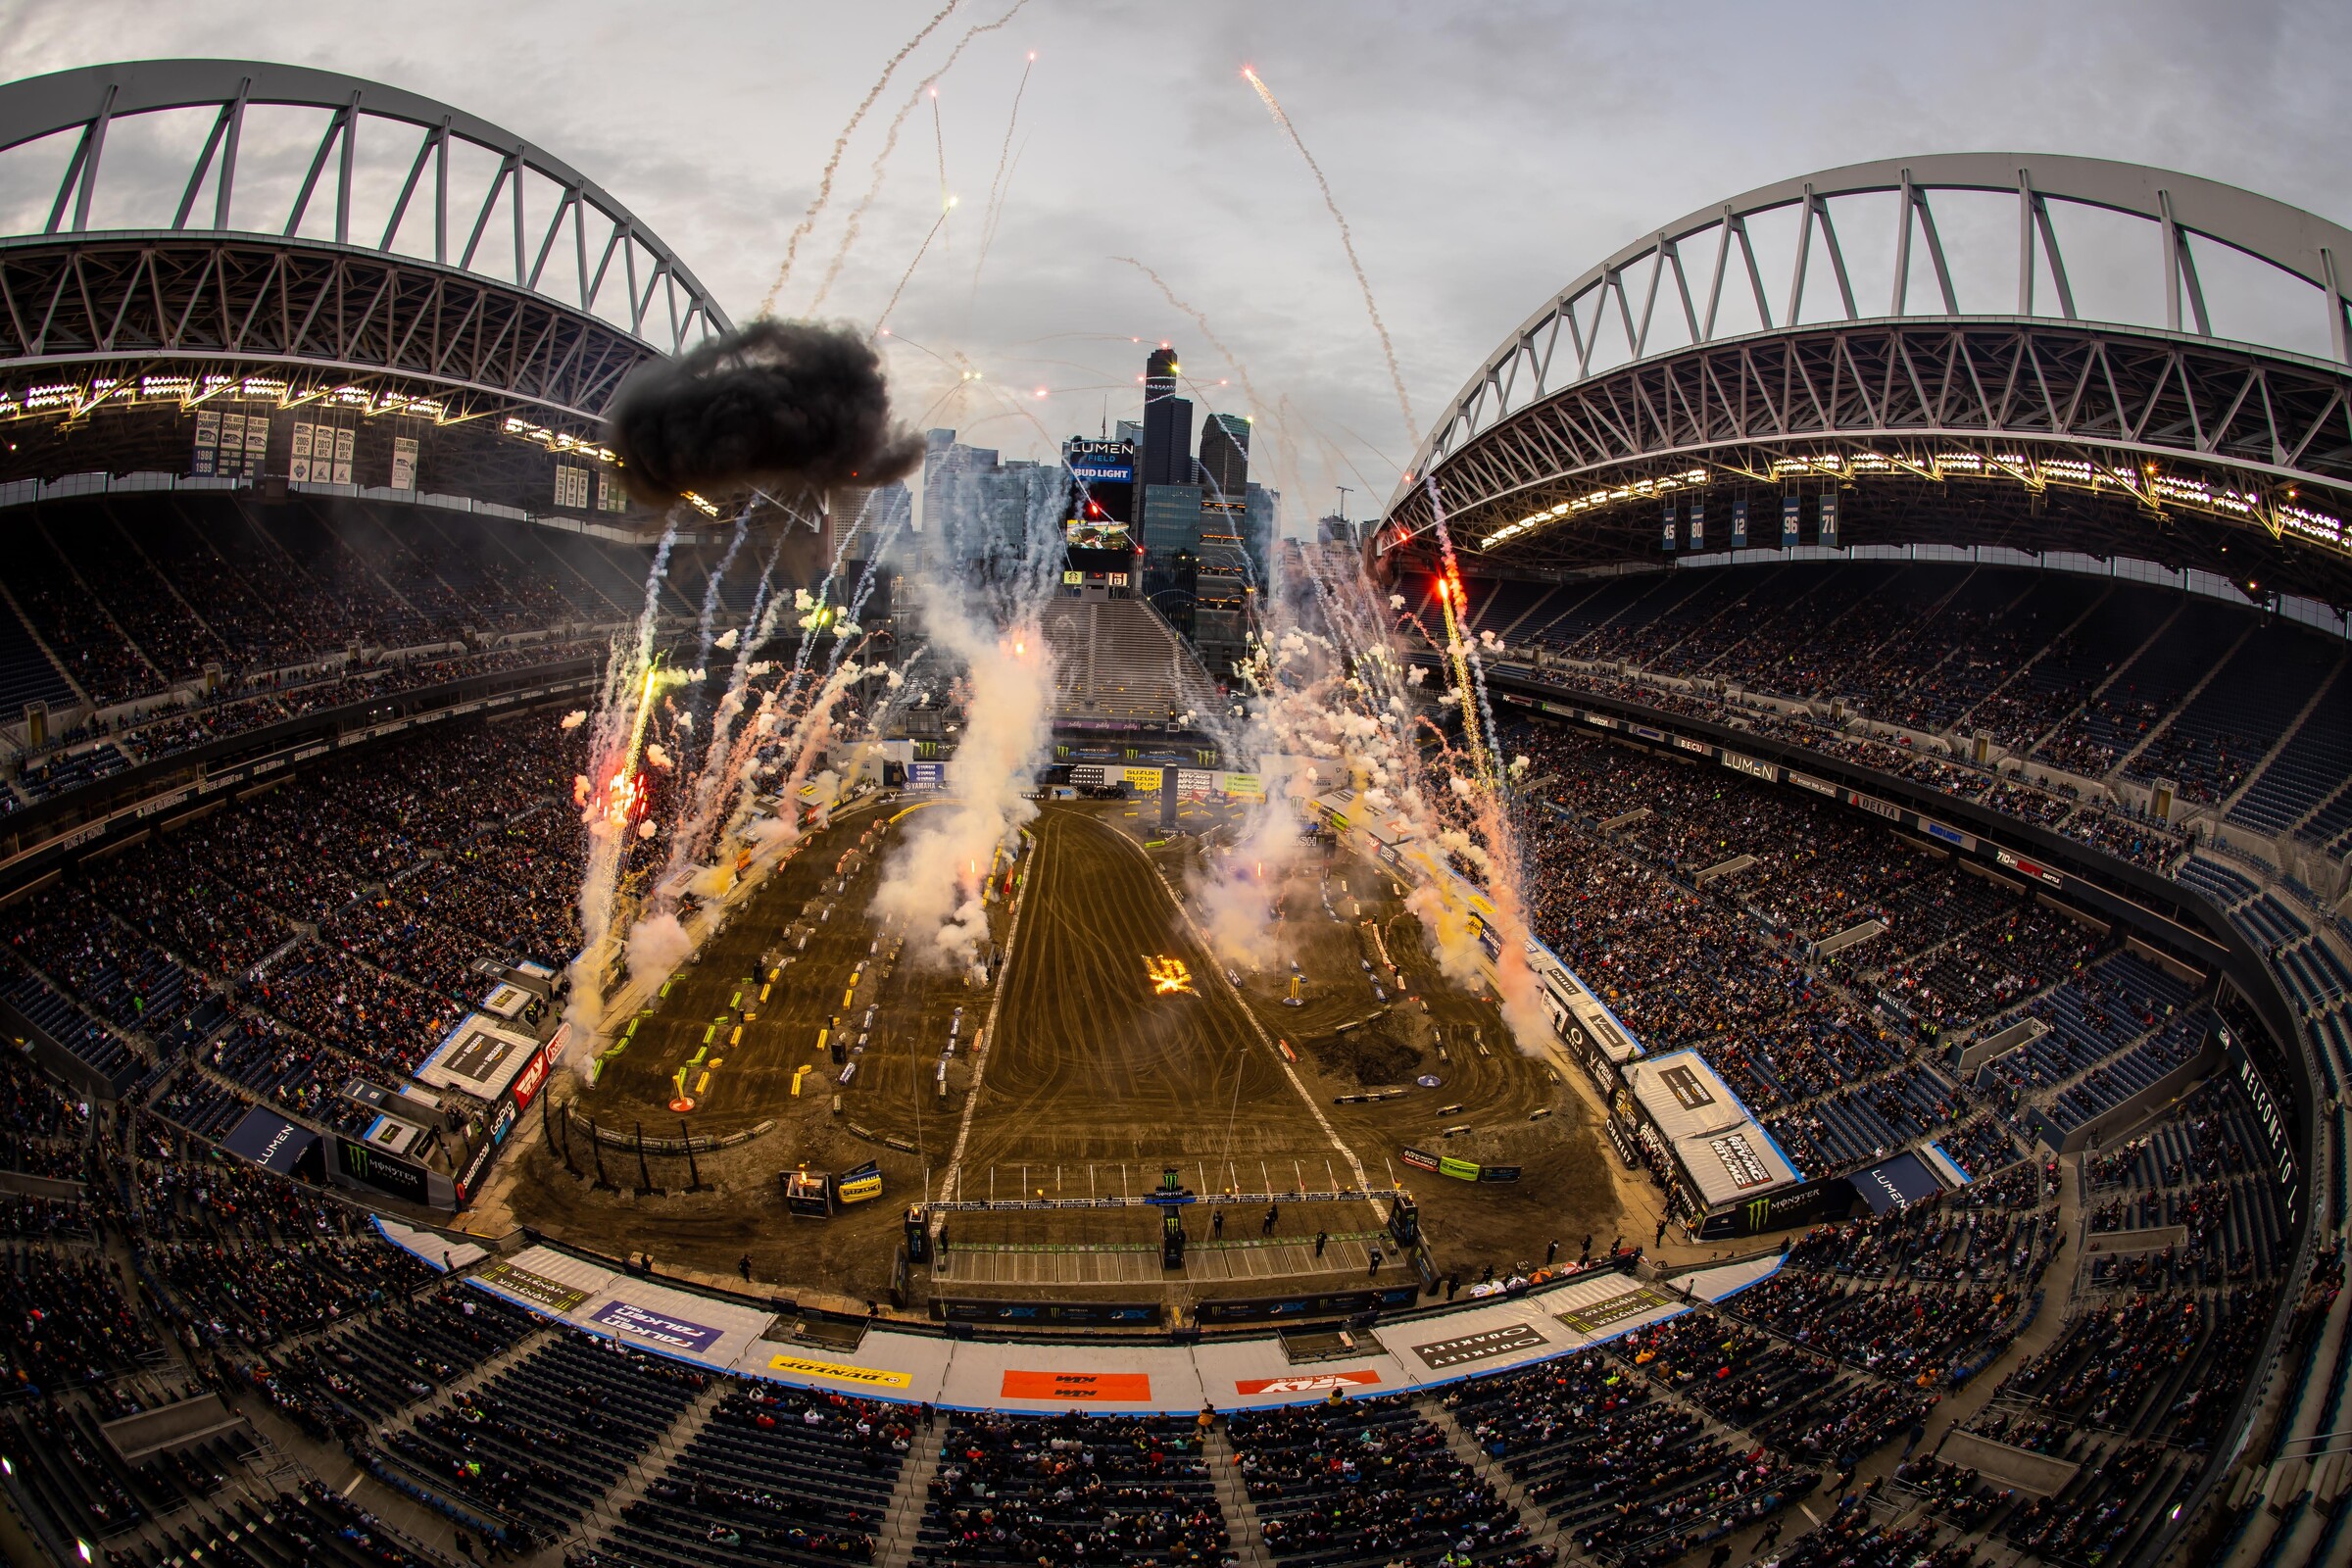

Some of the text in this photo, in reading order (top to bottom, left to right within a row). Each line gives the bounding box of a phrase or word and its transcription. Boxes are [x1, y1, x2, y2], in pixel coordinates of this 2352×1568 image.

[296, 436, 309, 446] 2005
[318, 439, 330, 448] 2013
[339, 442, 351, 451] 2014
[1071, 443, 1134, 455] LUMEN
[197, 451, 213, 460] 1988
[1088, 454, 1116, 463] FIELD
[196, 463, 212, 473] 1999
[1074, 468, 1128, 478] BUD LIGHT
[1664, 524, 1675, 540] 45
[1691, 522, 1702, 538] 80
[1734, 518, 1745, 535] 12
[1785, 516, 1797, 534] 96
[1822, 515, 1835, 534] 71
[1590, 716, 1608, 727] verizon
[1725, 753, 1773, 780] LUMEN
[1820, 784, 1835, 795] Services
[1863, 798, 1895, 818] DELTA
[64, 824, 106, 852] RING OF HONOR
[1929, 824, 1963, 843] BUD LIGHT
[1996, 851, 2010, 863] 710
[2042, 872, 2060, 884] SEATTLE
[1482, 928, 1501, 951] FALKEN
[254, 958, 271, 973] DELTA
[1883, 994, 1899, 1009] DELTA
[464, 1035, 485, 1054] amazon
[484, 1042, 506, 1061] amazon
[1566, 1034, 1583, 1056] OAKLEY
[516, 1054, 544, 1094] FLY
[1596, 1060, 1614, 1082] SPECIAL
[1677, 1086, 1694, 1104] amazon
[1691, 1082, 1709, 1101] amazon
[490, 1100, 514, 1136] GoPro
[2241, 1059, 2281, 1150] WELCOME
[2278, 1148, 2291, 1184] TO
[257, 1123, 294, 1165] LUMEN
[1611, 1129, 1632, 1162] OAKLEY
[1448, 1164, 1477, 1175] Kawasaki
[1724, 1146, 1752, 1184] ROCKY MOUNTAIN
[1740, 1141, 1770, 1179] ROCKY MOUNTAIN
[369, 1158, 417, 1184] MONSTER
[843, 1184, 880, 1197] SUZUKI
[1872, 1169, 1907, 1209] LUMEN
[1771, 1188, 1820, 1210] MONSTER
[498, 1278, 554, 1303] MONSTER
[512, 1270, 565, 1295] MONSTER
[623, 1304, 643, 1314] TIRES
[1581, 1296, 1638, 1317] MONSTER
[1594, 1303, 1652, 1325] MONSTER
[611, 1314, 631, 1323] TIRES
[614, 1307, 706, 1337] FALKEN
[602, 1317, 694, 1348] FALKEN
[1423, 1333, 1496, 1354] OAKLEY
[1434, 1344, 1510, 1366] OAKLEY
[779, 1362, 882, 1381] DUNLOP
[1258, 1377, 1363, 1394] FLY
